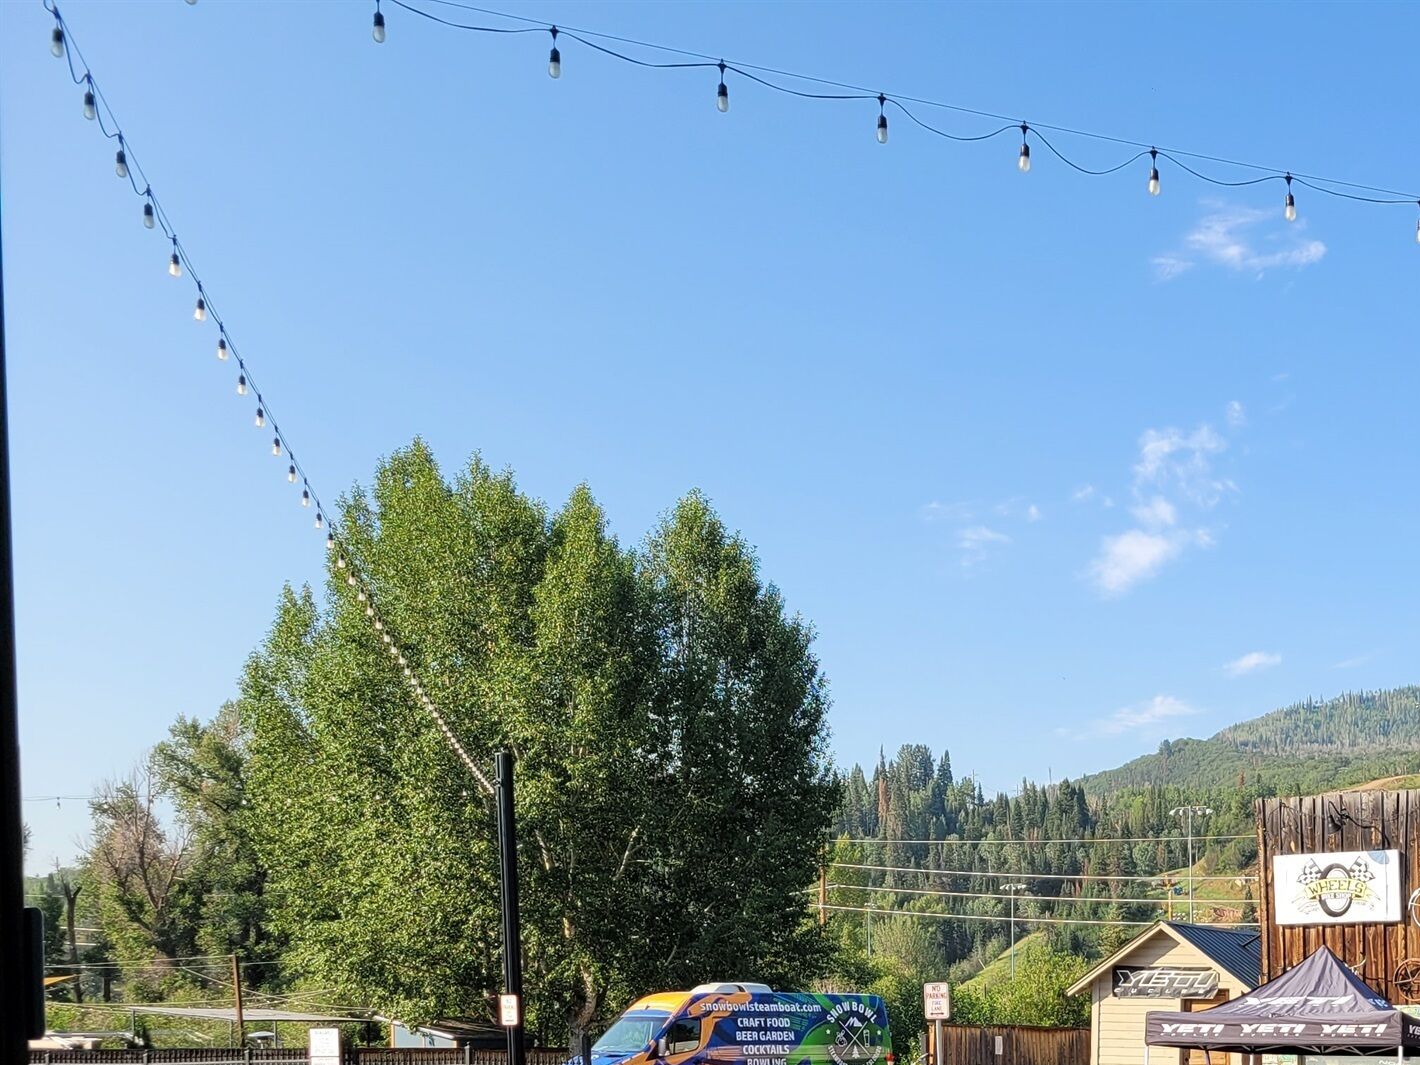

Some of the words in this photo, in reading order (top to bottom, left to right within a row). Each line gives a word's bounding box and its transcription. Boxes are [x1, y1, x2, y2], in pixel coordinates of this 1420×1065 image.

[1308, 880, 1364, 895] WHEELS
[1116, 970, 1216, 988] YETI
[701, 1001, 822, 1013] snowbowlsteamboat.com
[826, 1001, 850, 1024] SNOW
[851, 1001, 878, 1024] BOWL
[737, 1017, 766, 1028] CRAFT
[766, 1017, 791, 1028] FOOD
[1161, 1023, 1225, 1033] YETI
[1240, 1023, 1306, 1033] YETI
[1321, 1023, 1388, 1034] YETI
[736, 1031, 759, 1041] BEER
[758, 1031, 795, 1041] GARDEN
[742, 1045, 790, 1055] COCKTAILS
